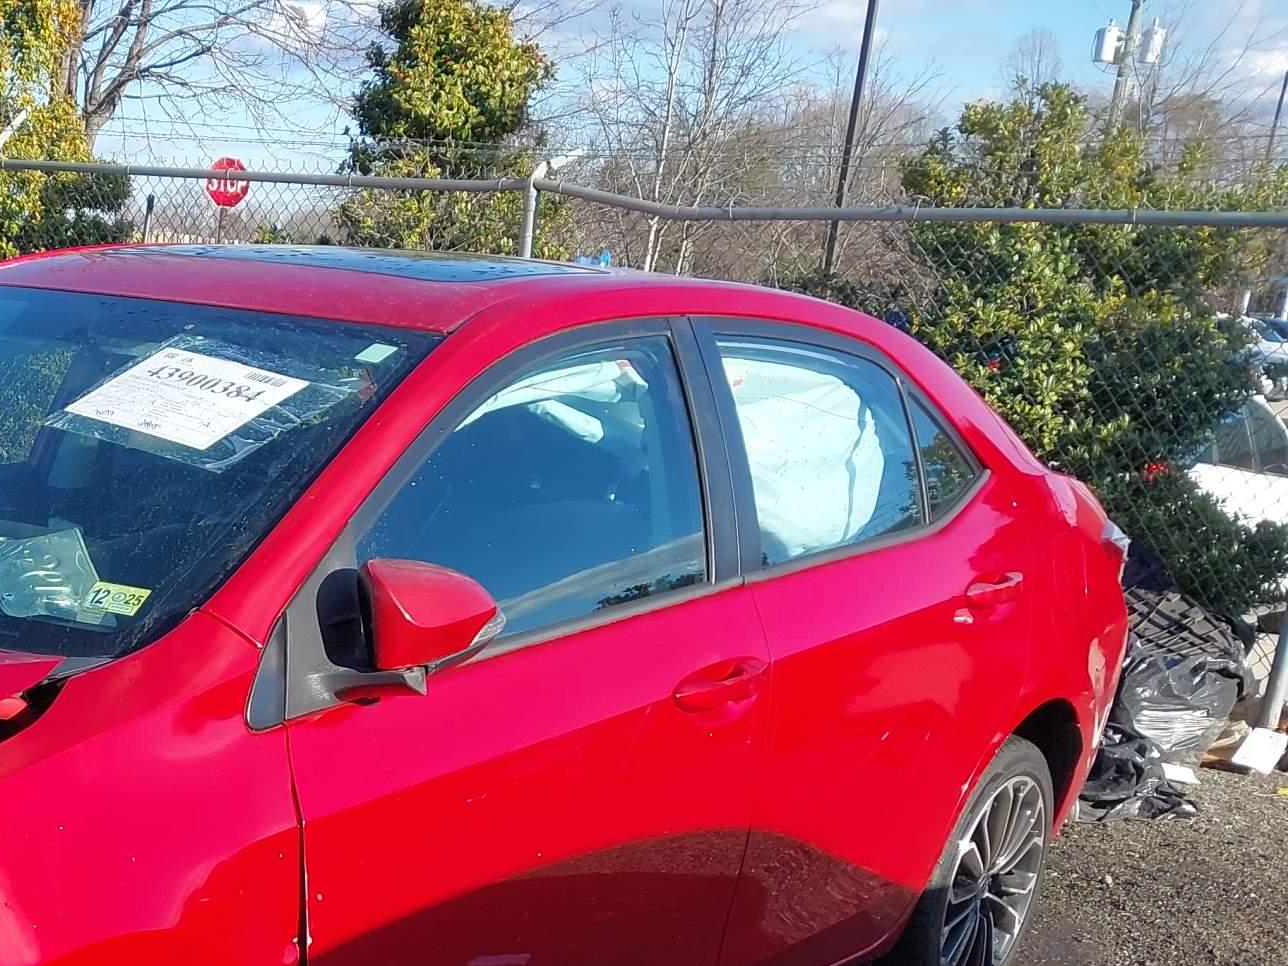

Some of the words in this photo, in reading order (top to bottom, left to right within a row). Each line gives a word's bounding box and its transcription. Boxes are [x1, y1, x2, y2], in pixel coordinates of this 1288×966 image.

[208, 176, 248, 194] STOP
[147, 365, 267, 403] 43900384
[89, 588, 111, 605] 12
[123, 593, 145, 607] 25
